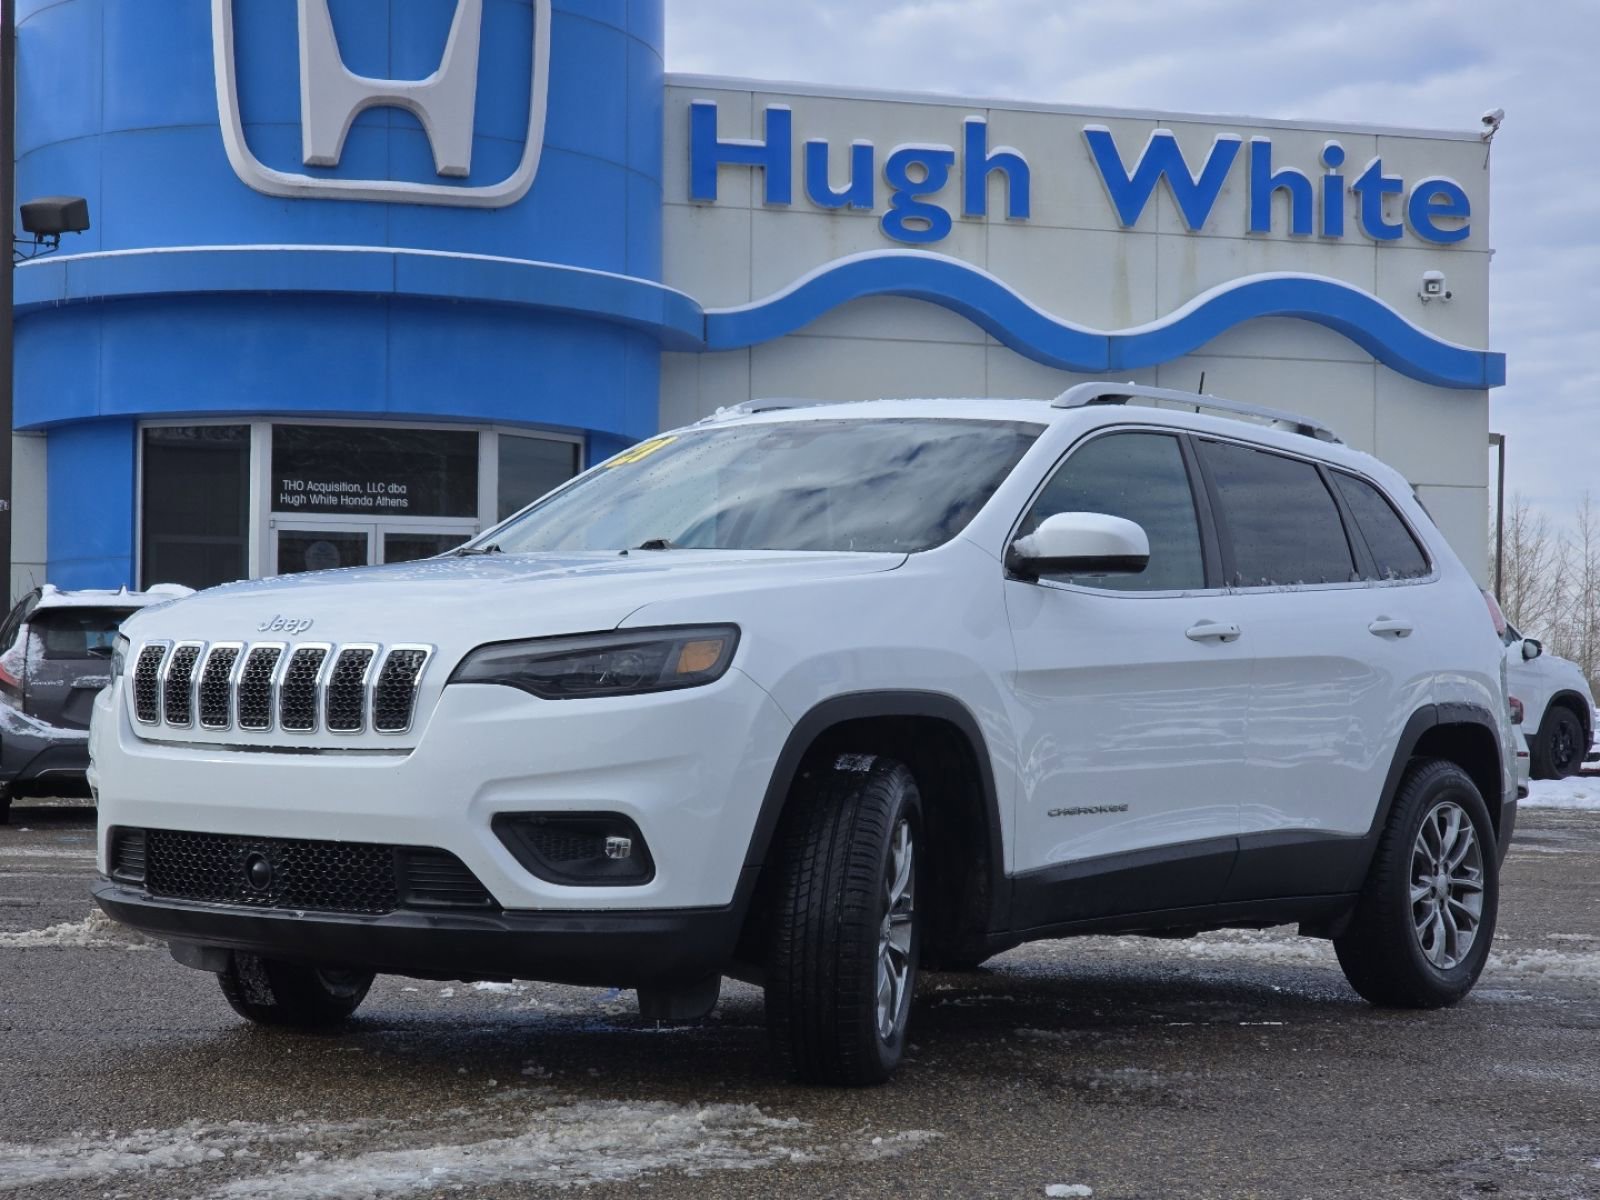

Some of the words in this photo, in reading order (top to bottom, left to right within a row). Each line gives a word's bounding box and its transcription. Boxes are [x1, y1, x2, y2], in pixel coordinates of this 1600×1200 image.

[689, 99, 1031, 244] Hugh
[1081, 124, 1472, 245] White
[282, 479, 304, 491] THO
[306, 480, 363, 494] Acquisition,
[367, 481, 386, 493] LLC
[387, 482, 407, 494] dba
[280, 492, 307, 507] Hugh
[309, 493, 338, 505] White
[340, 495, 373, 506] Honda
[375, 495, 409, 508] Athens
[257, 614, 314, 636] Jeep
[1047, 803, 1129, 818] CHEROKEE
